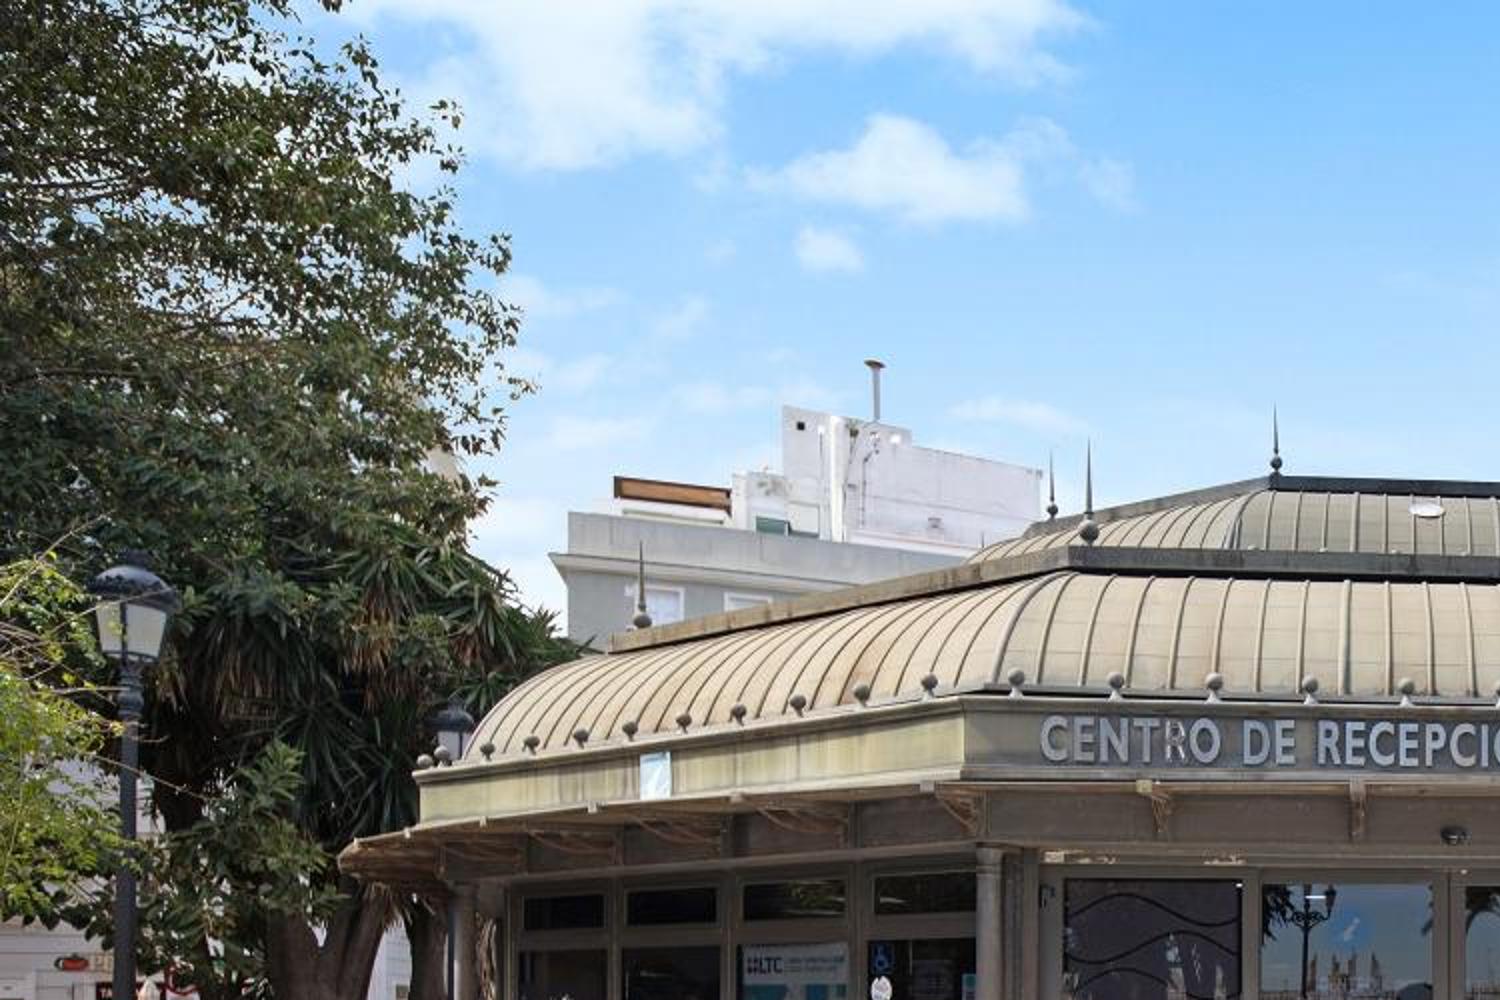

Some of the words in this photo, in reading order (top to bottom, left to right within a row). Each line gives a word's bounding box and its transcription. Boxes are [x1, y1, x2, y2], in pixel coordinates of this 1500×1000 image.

[1040, 715, 1222, 764] CENTRO
[1243, 718, 1297, 765] DE
[759, 956, 783, 974] LTC
